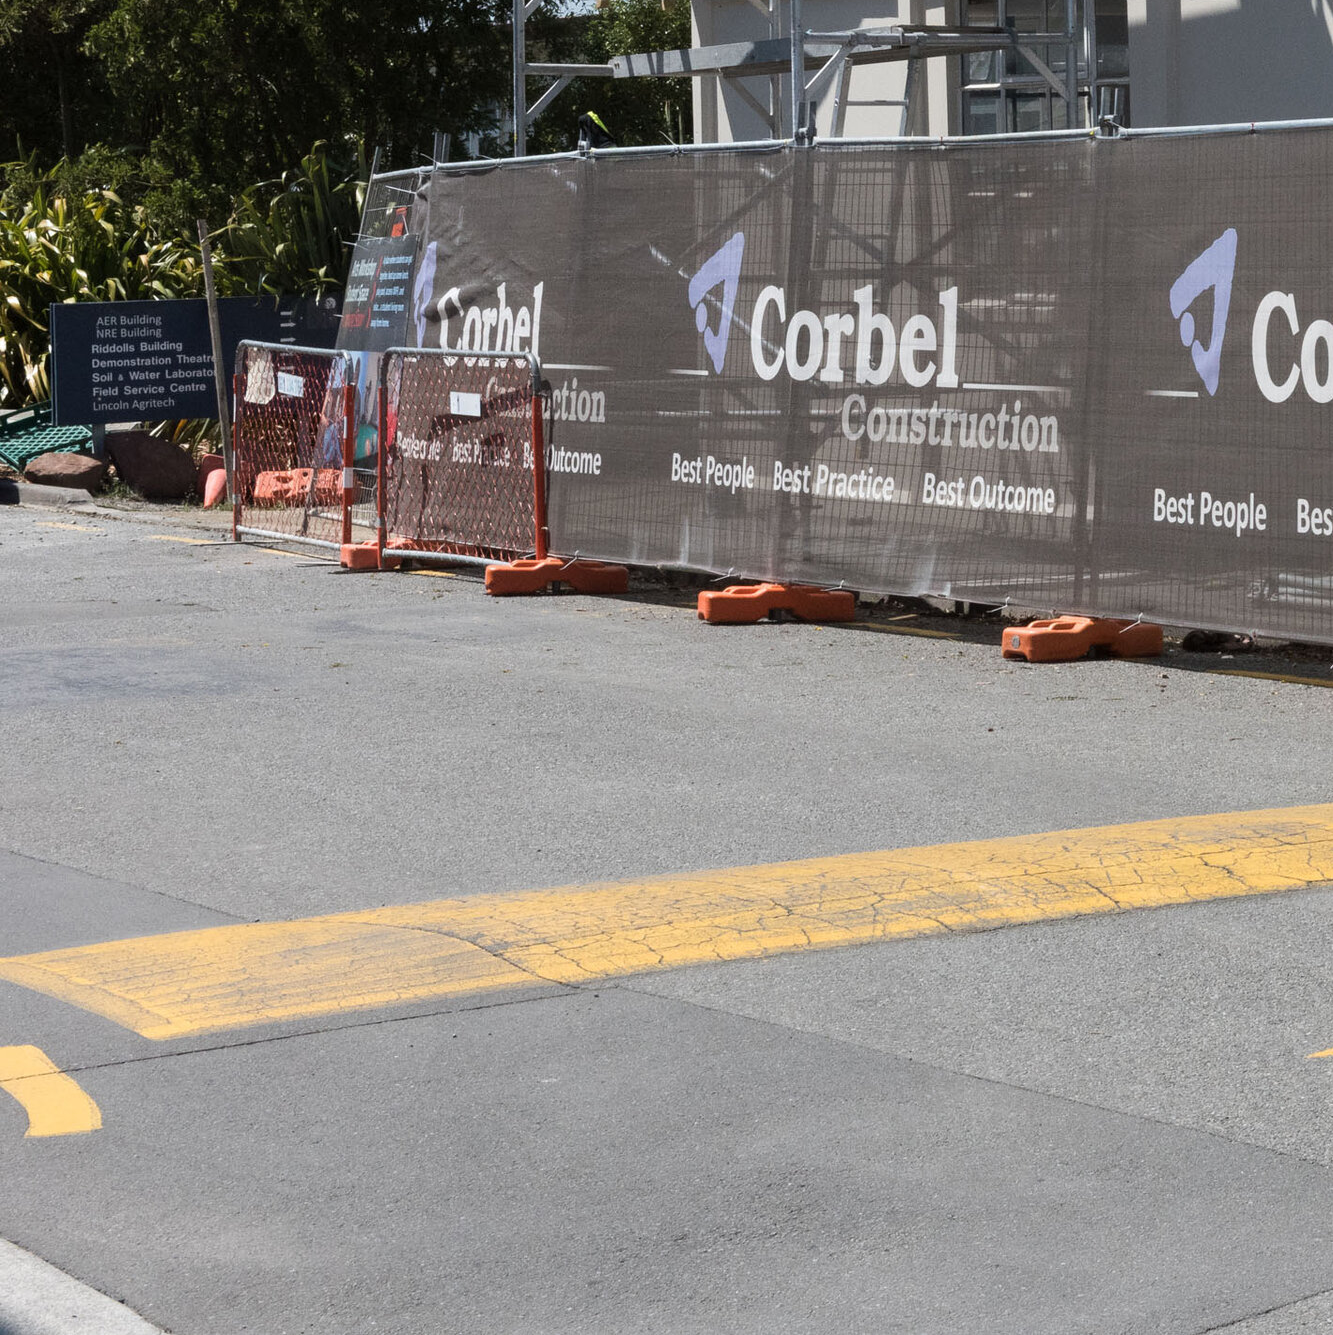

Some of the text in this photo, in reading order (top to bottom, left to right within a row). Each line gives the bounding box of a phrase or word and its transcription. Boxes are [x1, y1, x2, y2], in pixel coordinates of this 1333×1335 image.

[96, 315, 162, 326] AER Building
[437, 281, 544, 368] Corbel
[96, 327, 162, 339] NRE Building
[750, 284, 959, 388] Corbel
[91, 341, 183, 354] Riddolls Building
[91, 356, 172, 369] Demonstration
[91, 372, 113, 383] Soil
[129, 370, 161, 382] Water
[92, 382, 207, 397] Field Service Centre
[93, 397, 175, 411] Lincoln Agritech
[841, 393, 1059, 453] Construction
[671, 453, 1056, 514] Best People Best Practice Best Outcome
[1153, 487, 1195, 524] Best
[1199, 491, 1268, 537] People
